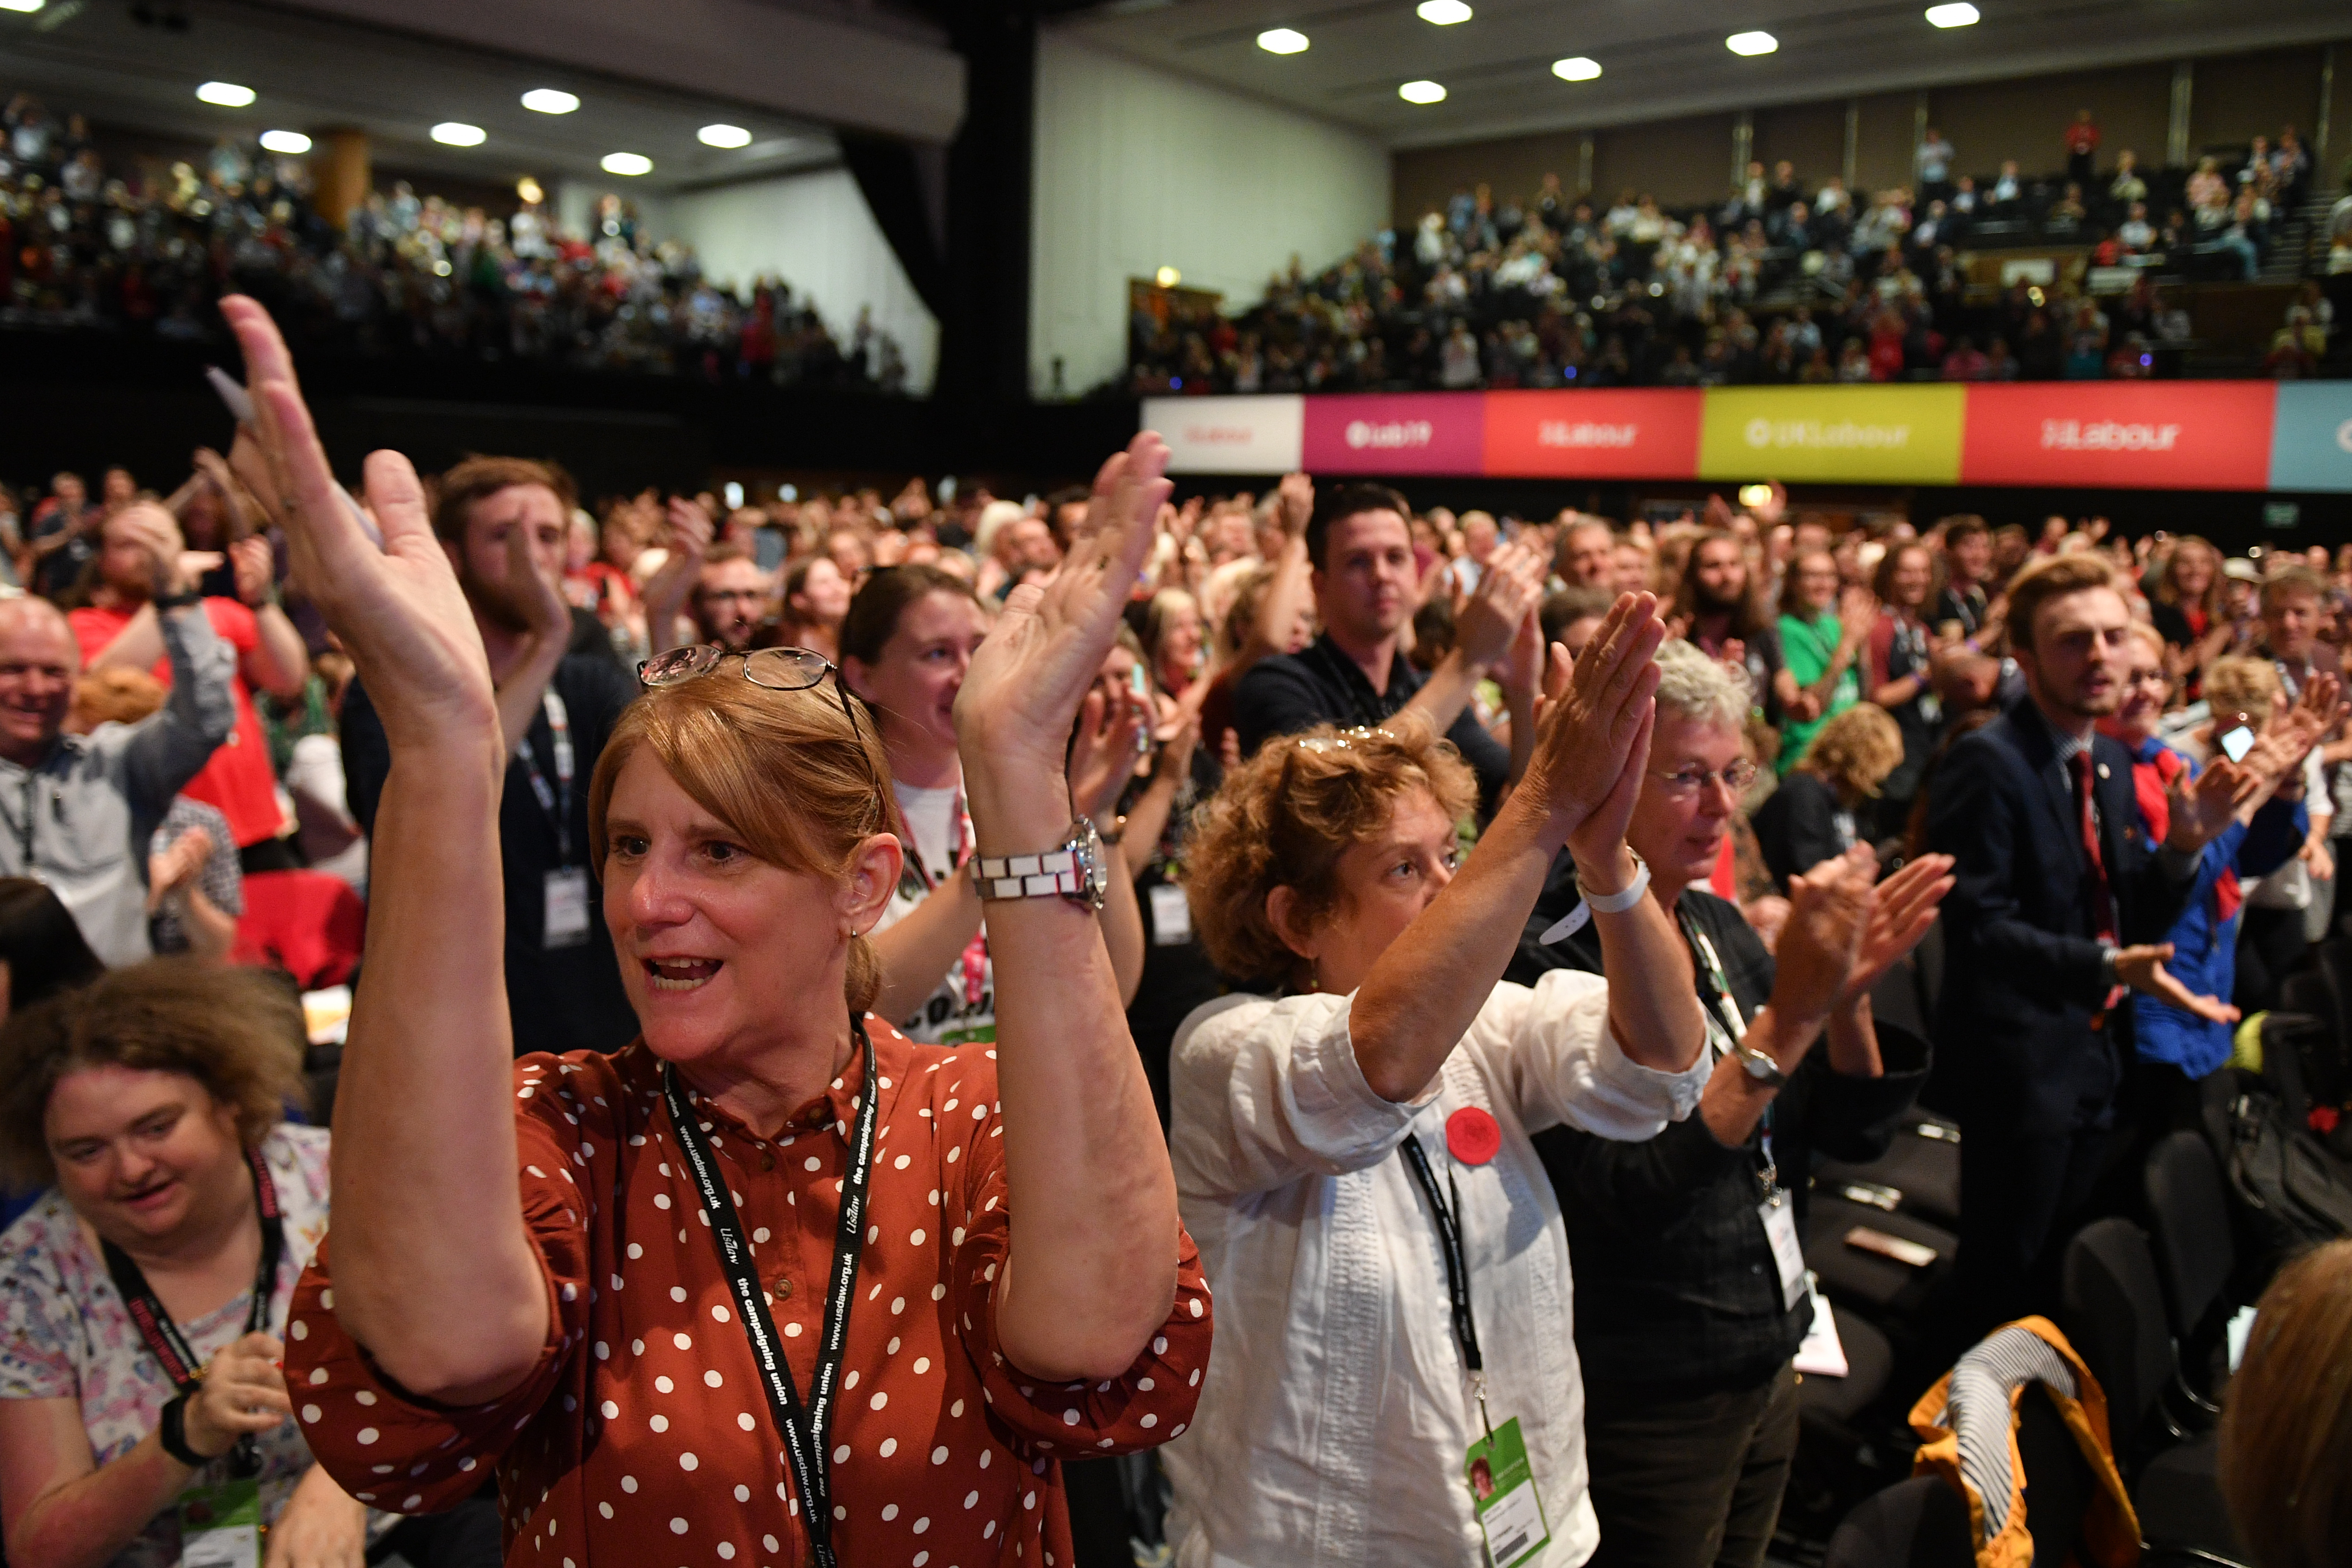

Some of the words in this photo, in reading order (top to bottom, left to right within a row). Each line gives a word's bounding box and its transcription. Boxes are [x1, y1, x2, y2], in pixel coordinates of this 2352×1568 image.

[2062, 419, 2181, 450] Labour
[679, 1125, 721, 1209] www.usdaw.org.uk
[858, 1104, 875, 1166] campaigning
[853, 1166, 864, 1185] the
[720, 1228, 739, 1264] Usdaw
[846, 1195, 860, 1234] Usdaw
[830, 1252, 853, 1350] www.usdaw.org.uk
[737, 1277, 750, 1296] the
[745, 1299, 776, 1370] campaigning
[770, 1372, 788, 1405] union
[810, 1397, 827, 1475] campaigning
[820, 1362, 833, 1395] union
[785, 1418, 817, 1523] www.usdaw.org.uk
